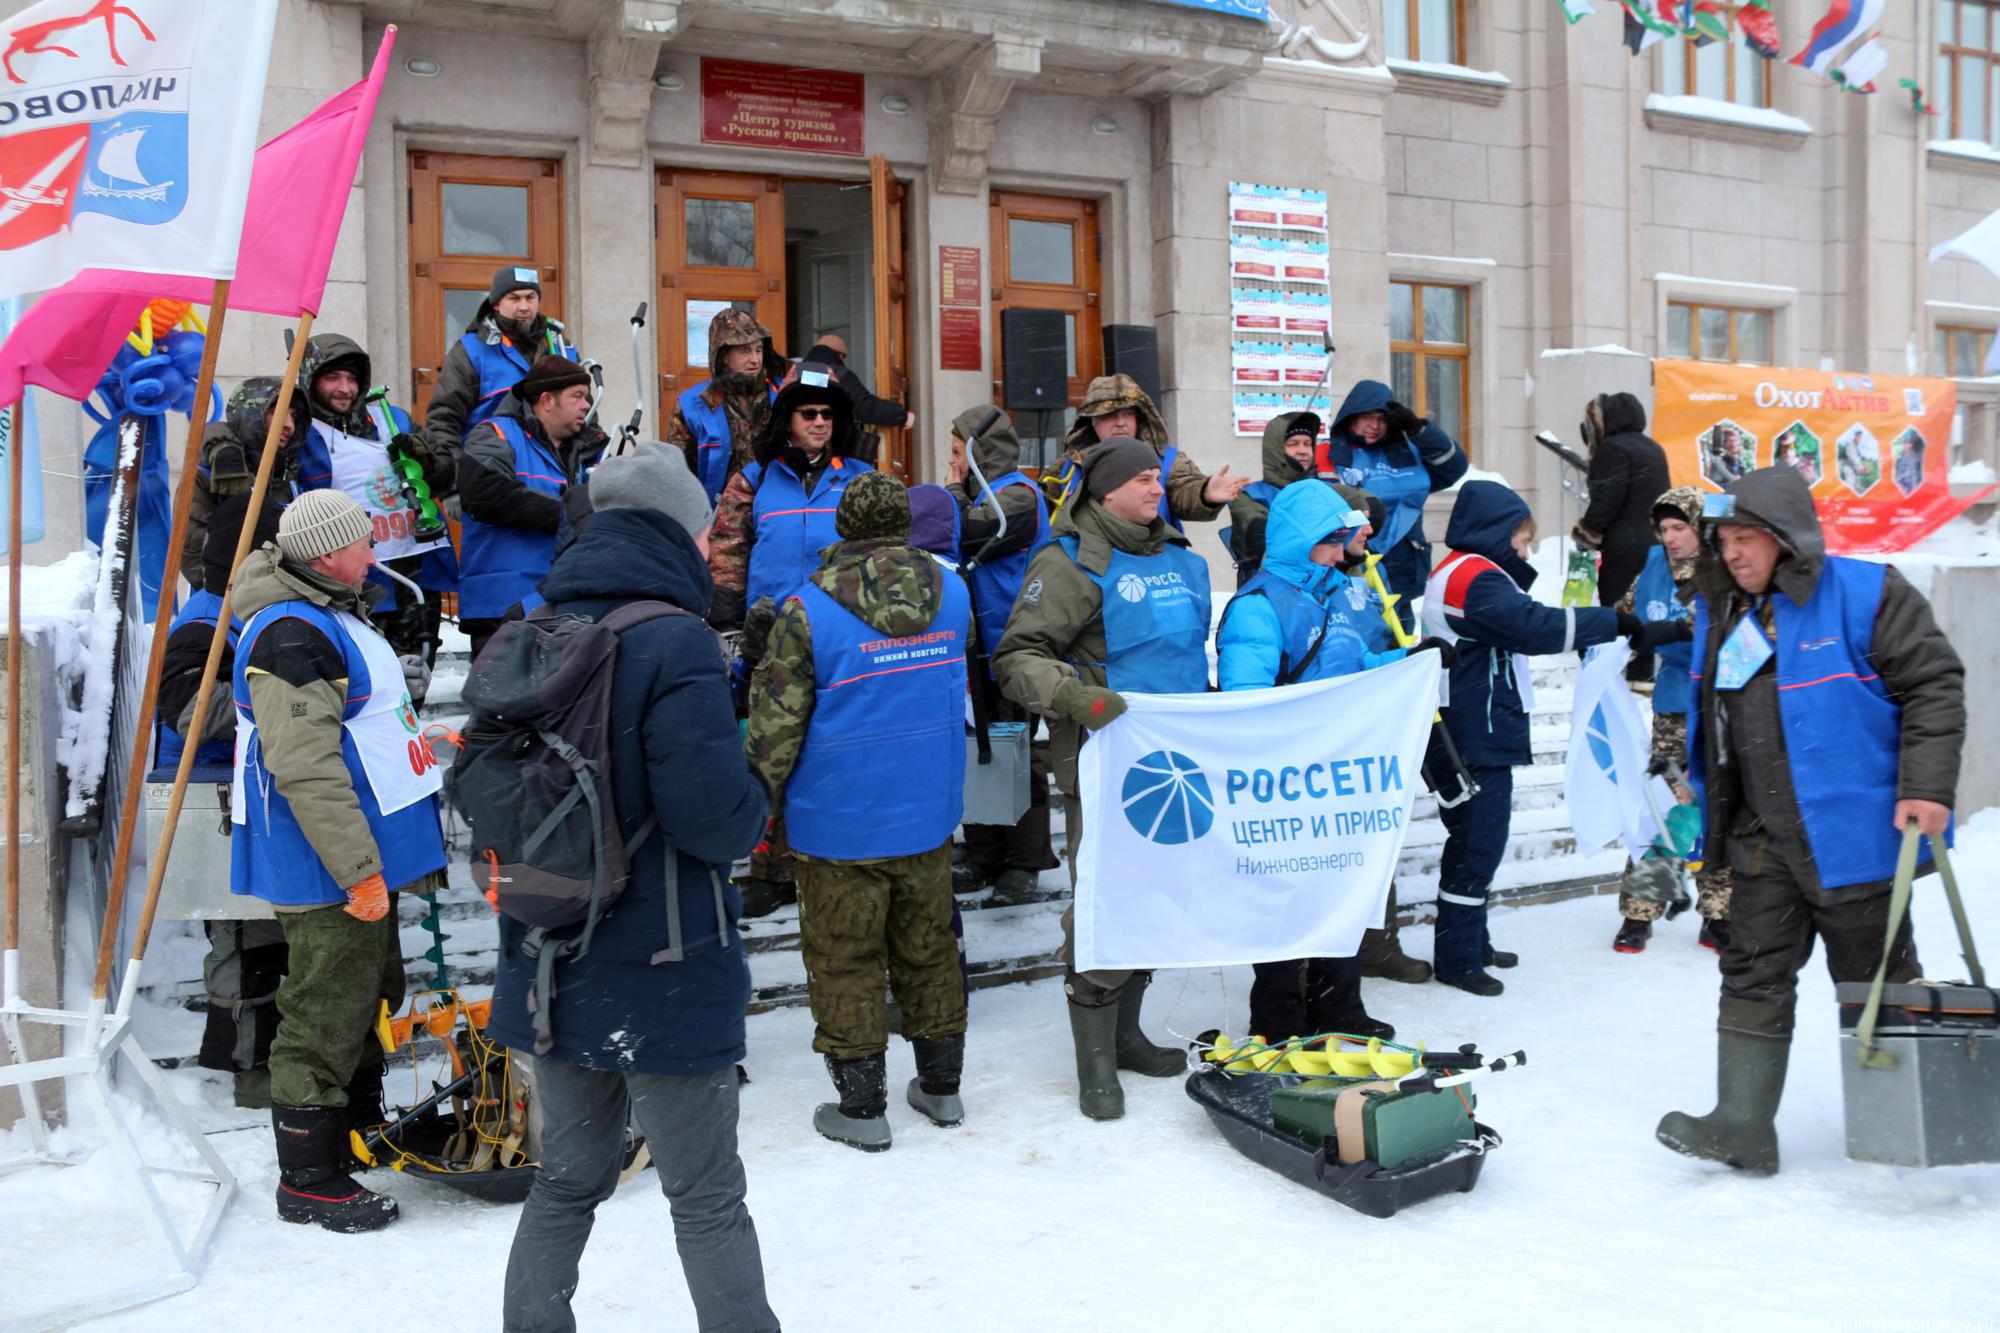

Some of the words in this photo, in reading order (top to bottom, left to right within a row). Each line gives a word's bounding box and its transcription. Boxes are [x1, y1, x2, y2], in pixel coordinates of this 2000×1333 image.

[783, 116, 836, 131] туризма
[858, 630, 956, 653] ТЕПЛОЭНЕРГО
[873, 650, 909, 664] НИЖНИЙ
[910, 646, 948, 659] НОВГОРОД
[1226, 755, 1403, 804] РОССЕТИ
[1232, 817, 1303, 848] ЦЕНТР
[1311, 814, 1329, 838] И
[1236, 851, 1364, 876] Нижновэнерго
